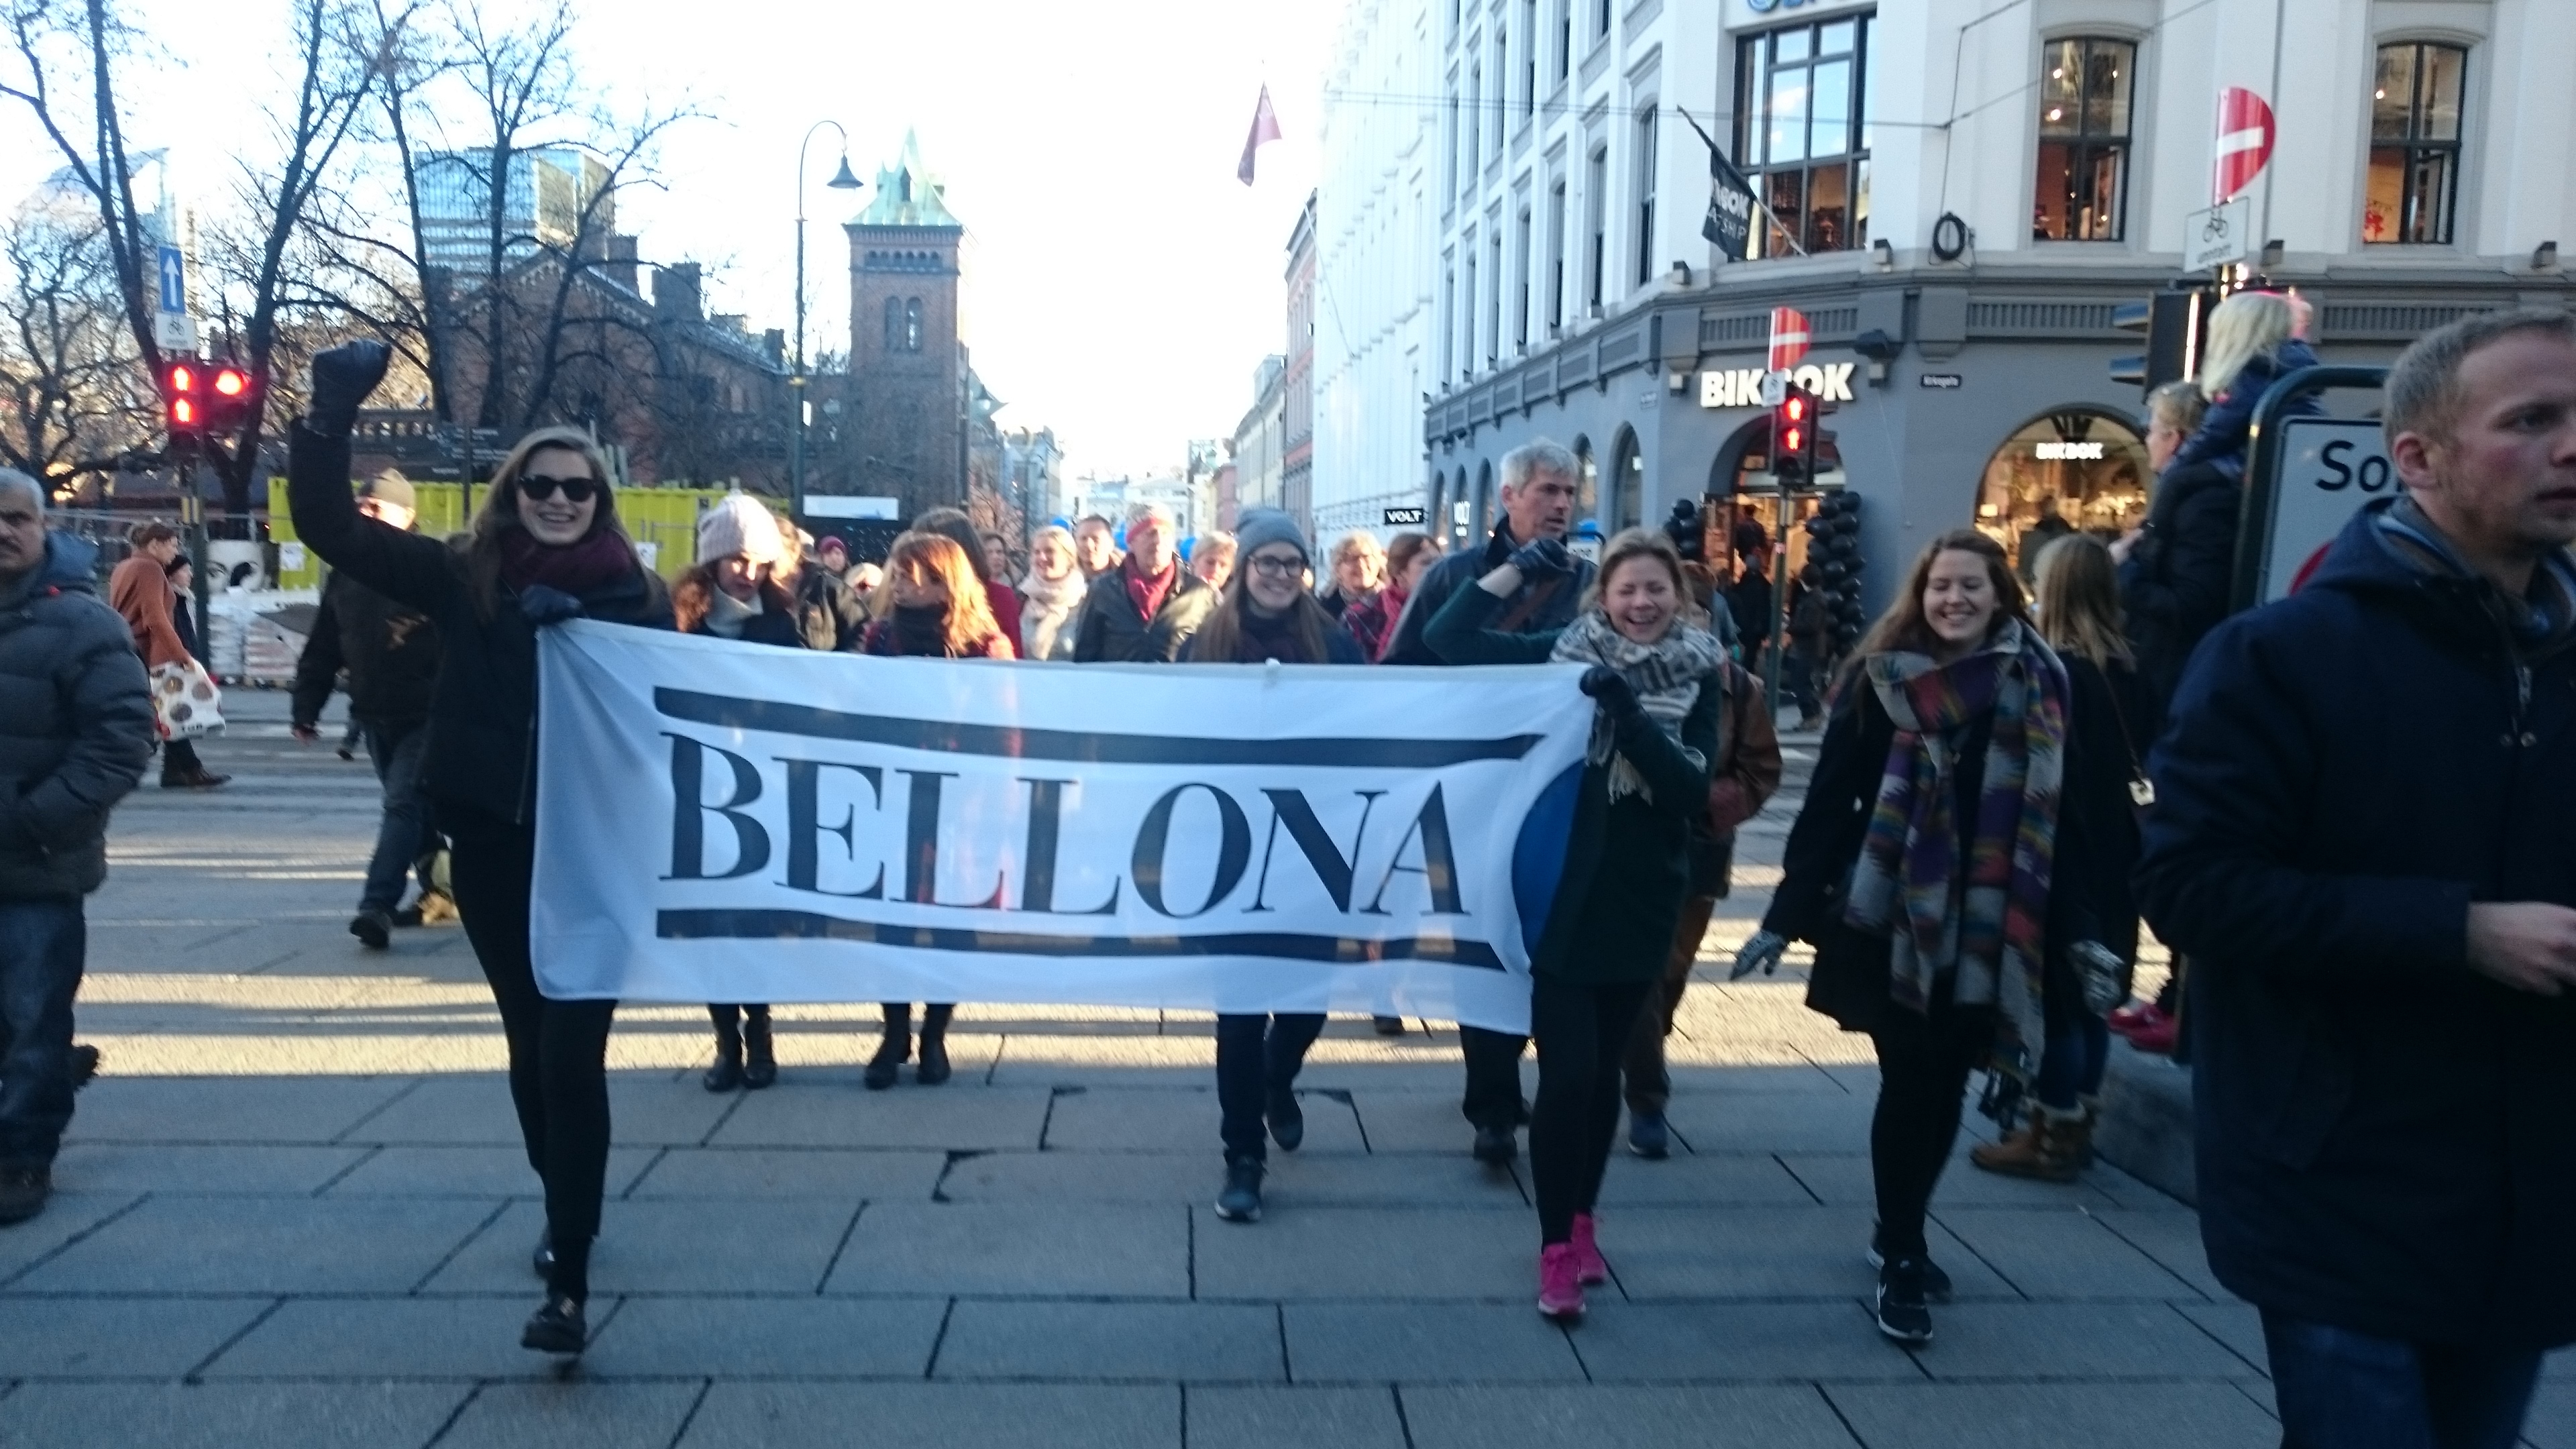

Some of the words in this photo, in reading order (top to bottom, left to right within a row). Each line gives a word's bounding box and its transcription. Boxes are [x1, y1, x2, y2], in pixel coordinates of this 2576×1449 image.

[1700, 362, 1856, 407] BIKOK
[2316, 439, 2404, 493] So
[1386, 509, 1421, 523] VOLT
[659, 731, 1471, 918] BELLONA
